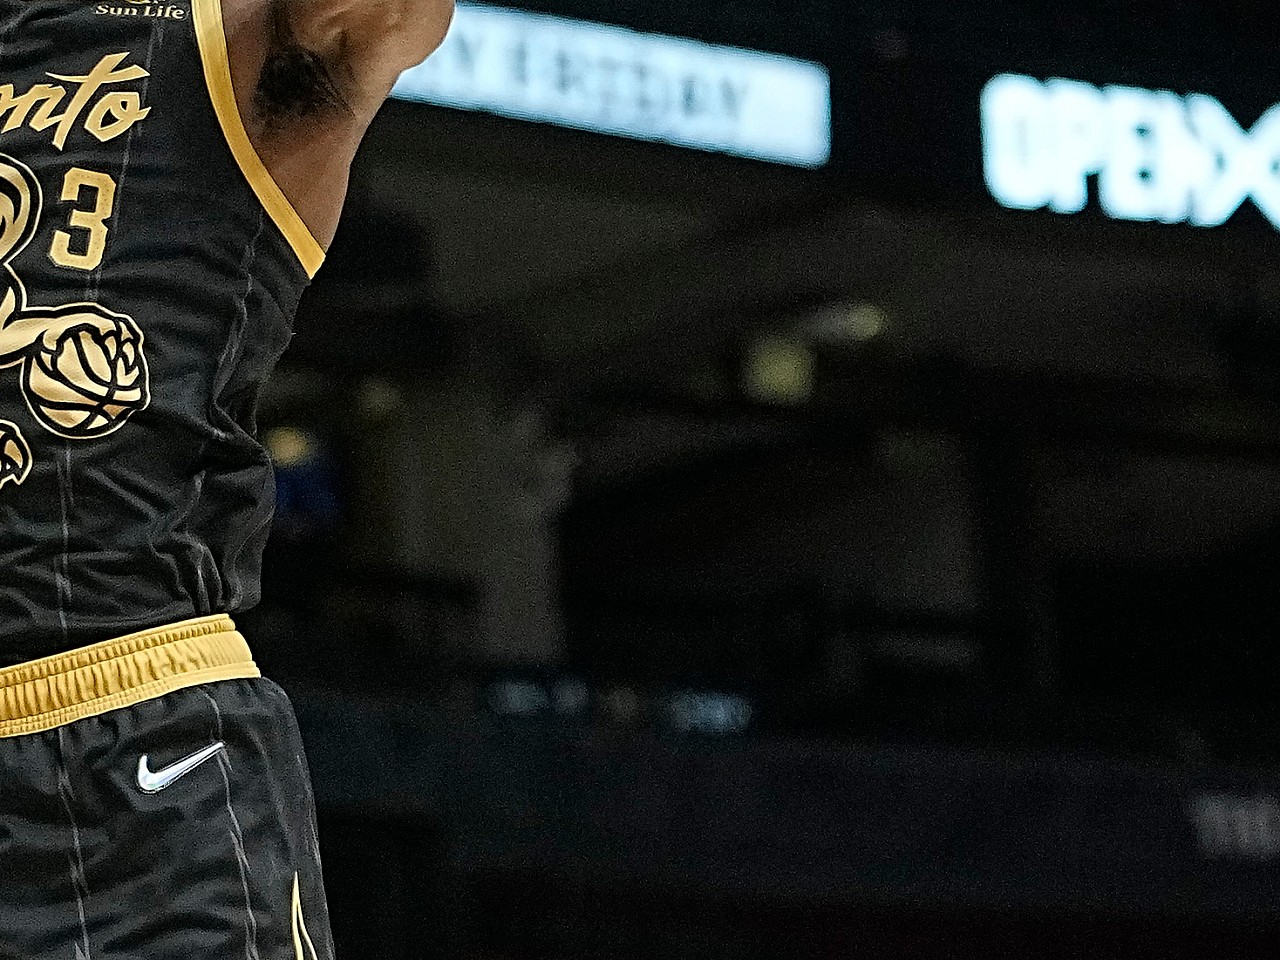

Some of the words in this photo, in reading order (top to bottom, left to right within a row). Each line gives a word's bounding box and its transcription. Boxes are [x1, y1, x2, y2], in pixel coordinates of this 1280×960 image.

[94, 4, 138, 16] Sun
[143, 4, 185, 20] Life
[49, 167, 116, 271] 3
